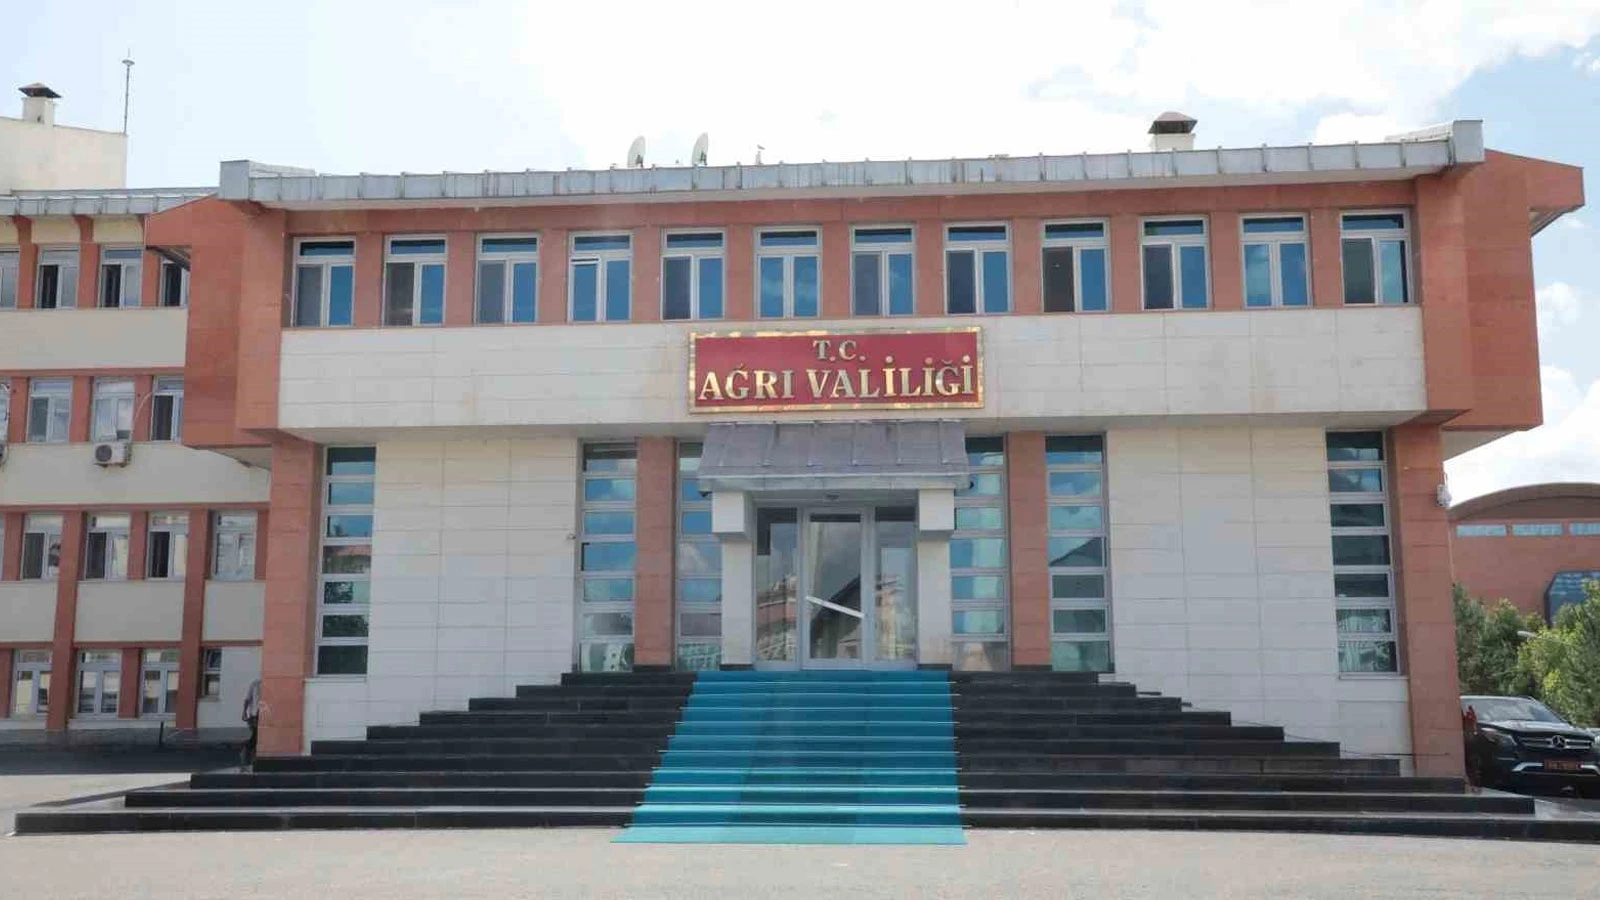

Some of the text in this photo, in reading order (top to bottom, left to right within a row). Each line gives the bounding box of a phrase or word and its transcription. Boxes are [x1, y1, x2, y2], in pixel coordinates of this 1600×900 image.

[813, 340, 866, 360] T.C.
[698, 355, 973, 400] AĞRI VALİLİĞİ
